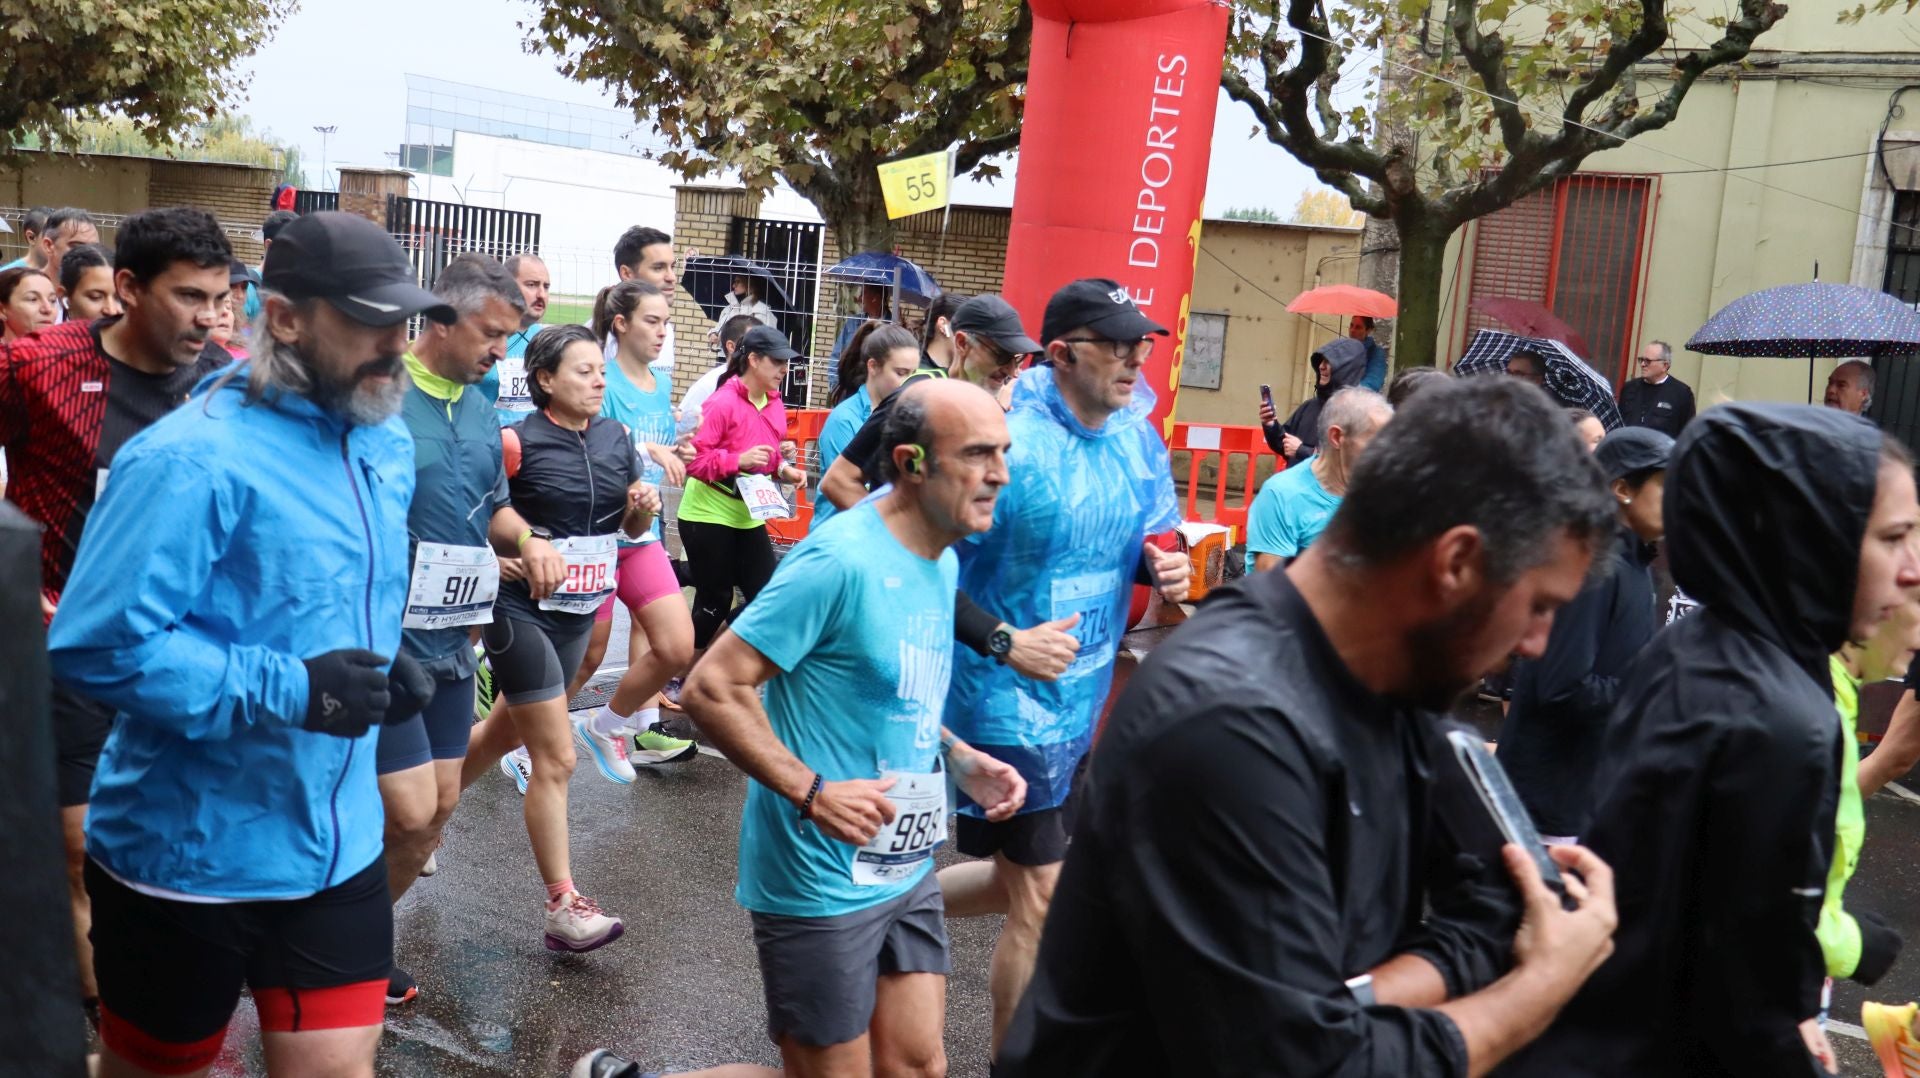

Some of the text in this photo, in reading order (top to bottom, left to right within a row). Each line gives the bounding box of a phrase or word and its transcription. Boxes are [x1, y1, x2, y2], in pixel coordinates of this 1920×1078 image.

[1128, 54, 1187, 268] DEPORTES
[906, 172, 936, 202] 55
[442, 576, 480, 606] 911
[566, 563, 607, 593] 909
[889, 807, 942, 853] 988
